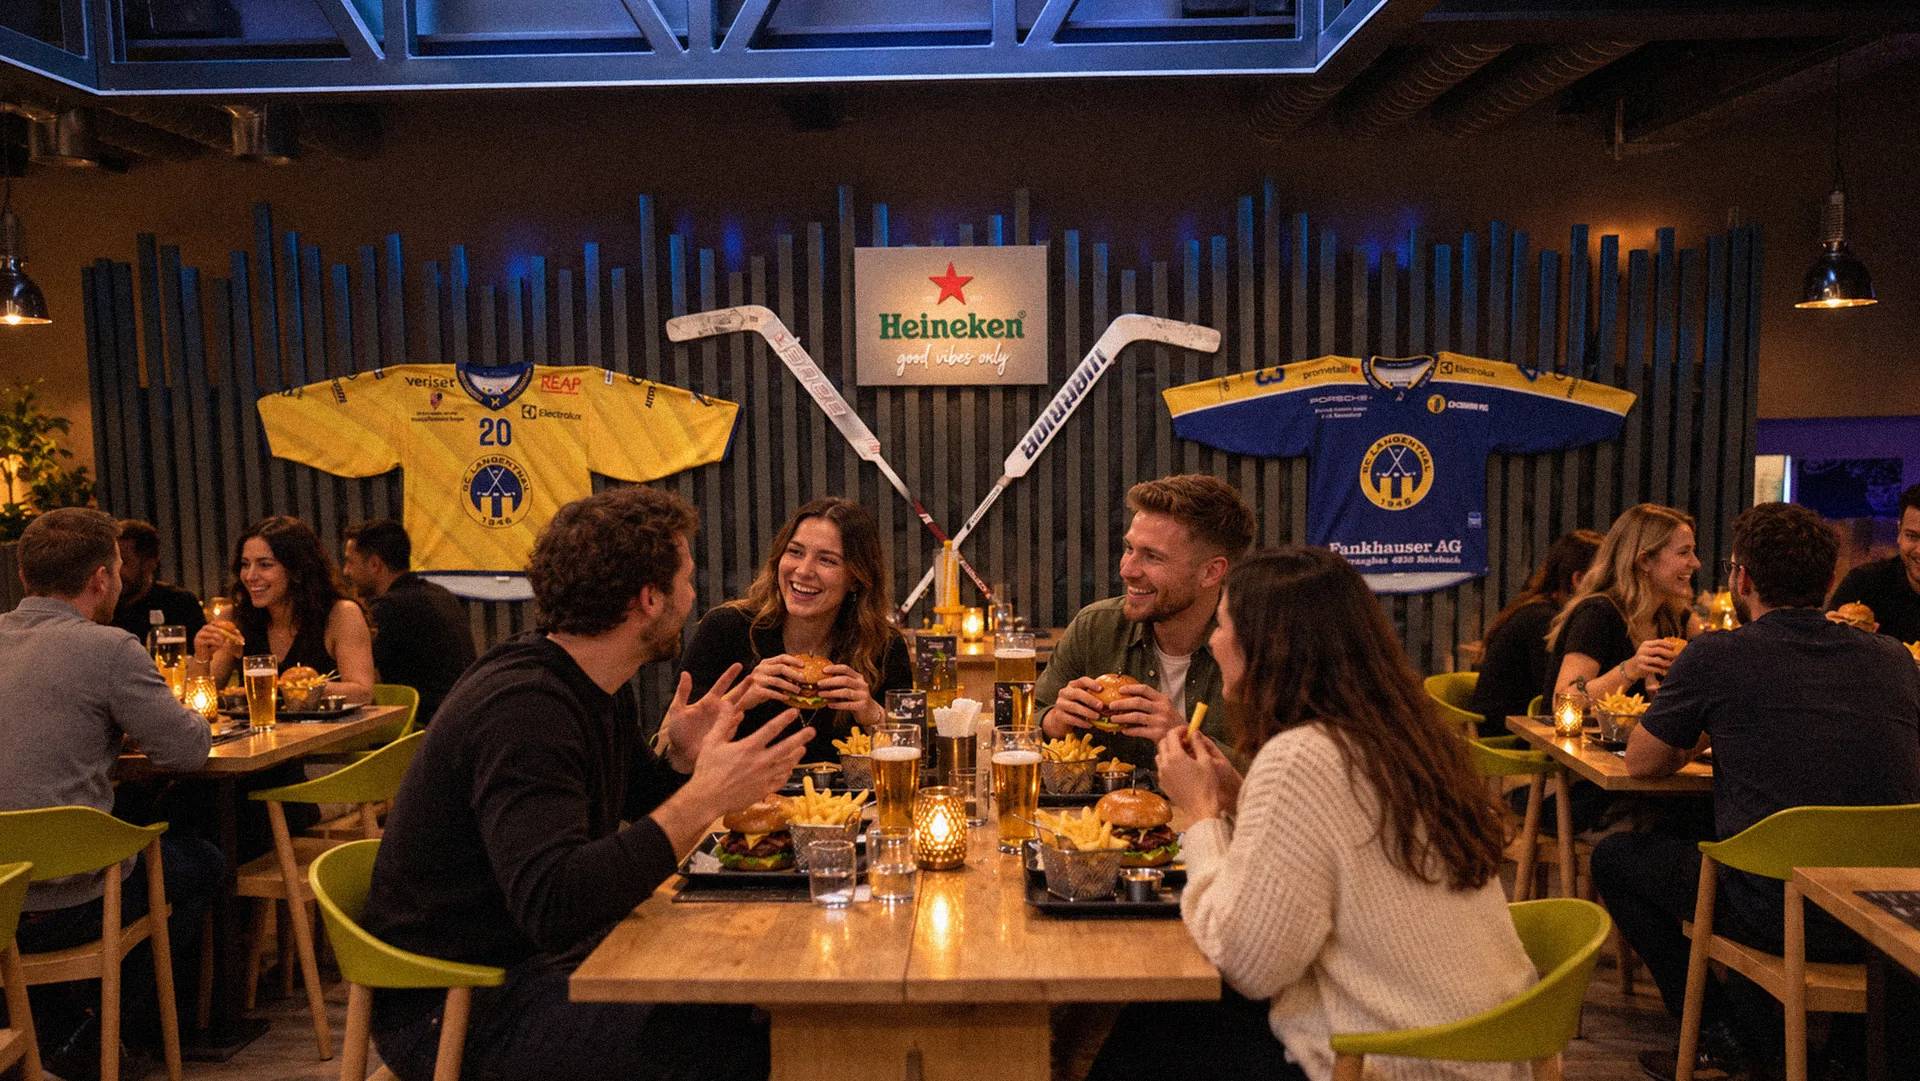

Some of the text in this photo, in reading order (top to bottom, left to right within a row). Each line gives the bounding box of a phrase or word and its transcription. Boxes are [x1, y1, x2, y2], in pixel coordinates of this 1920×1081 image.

[896, 342, 1010, 377] good vibes only
[404, 374, 456, 389] veriset
[540, 375, 582, 391] REAP
[538, 408, 582, 421] Electrolux
[478, 417, 512, 447] 20
[1329, 539, 1462, 556] Fankhauser AG
